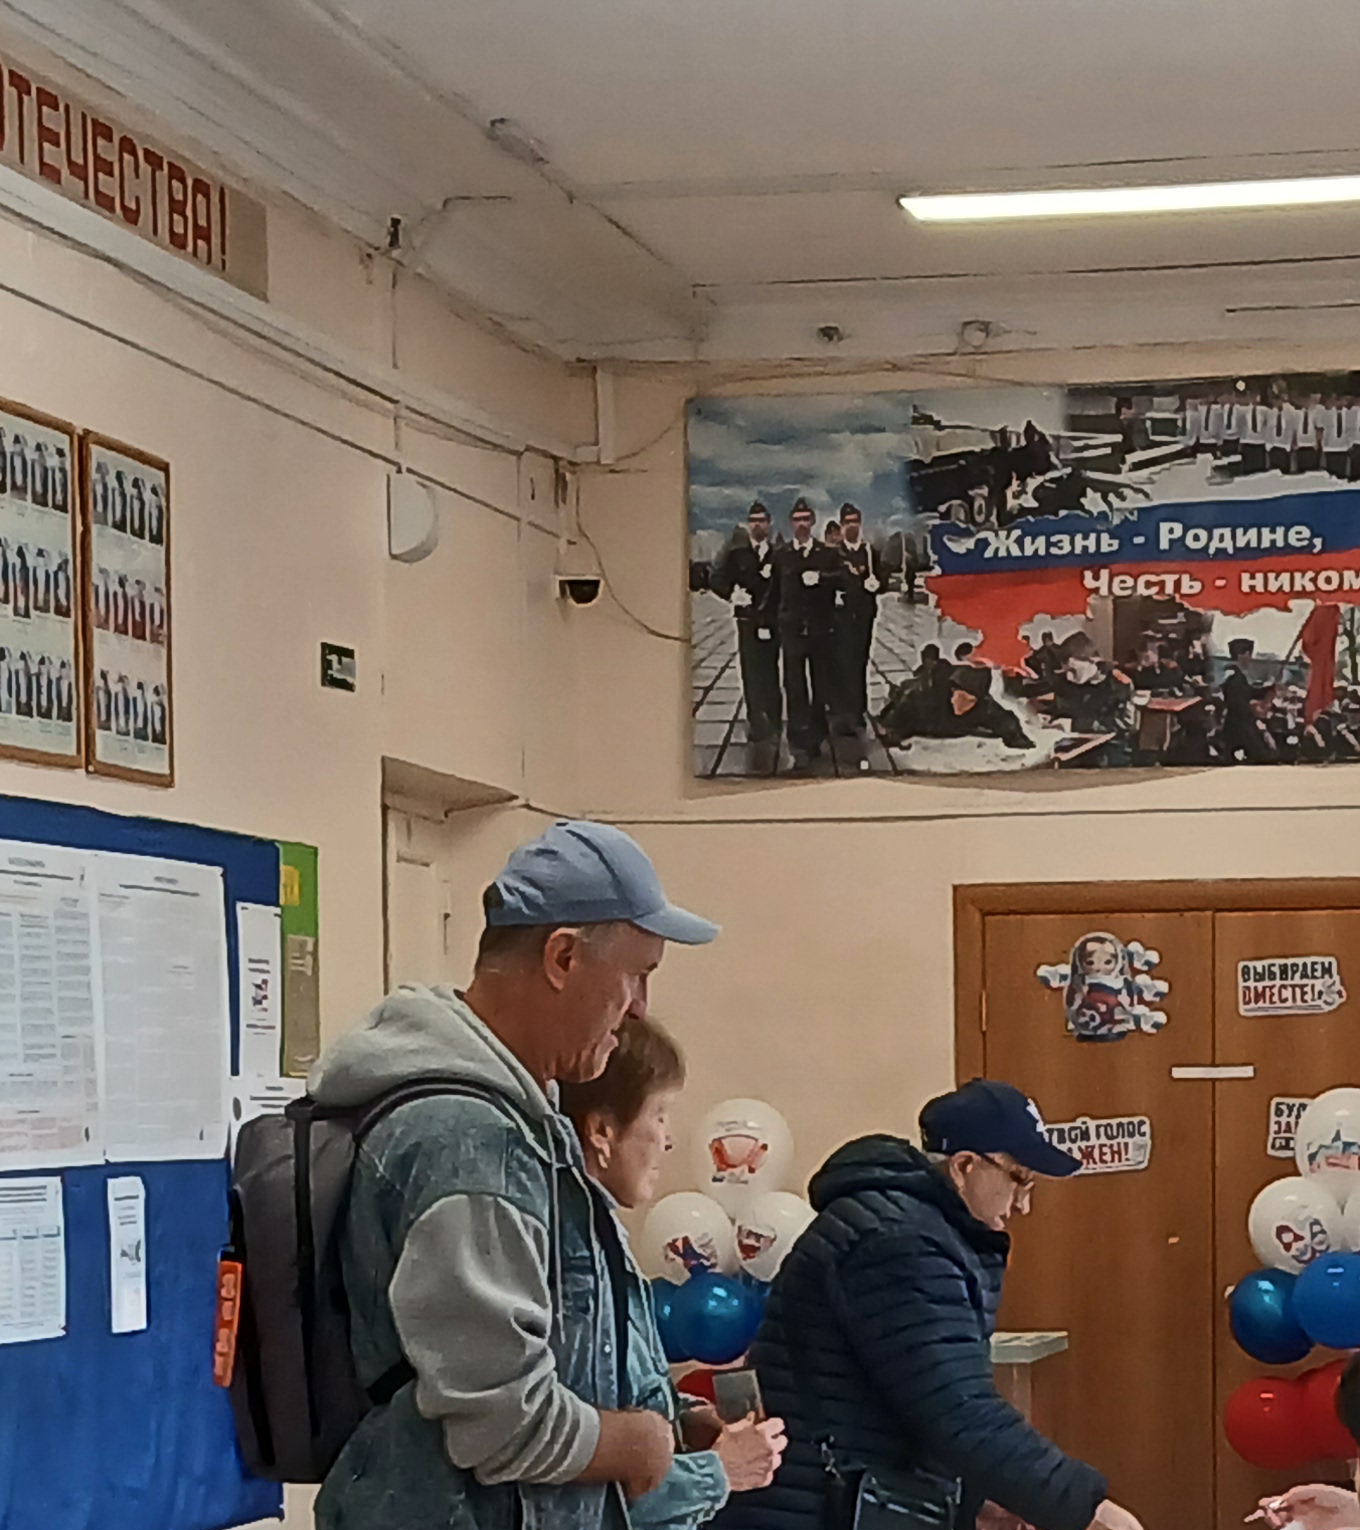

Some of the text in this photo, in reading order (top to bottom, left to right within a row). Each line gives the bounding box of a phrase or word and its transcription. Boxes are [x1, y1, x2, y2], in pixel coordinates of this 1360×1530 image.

[983, 528, 1120, 558] Жизнь
[1158, 521, 1324, 557] Родине,
[1083, 568, 1202, 596] Честь
[1241, 961, 1333, 983] ВЫБИРАЕМ
[1242, 983, 1317, 1006] ВМЕСТЕ!
[1045, 1119, 1147, 1144] ТВОЙ ГОЛОС
[1066, 1141, 1130, 1165] ЖЕН!
